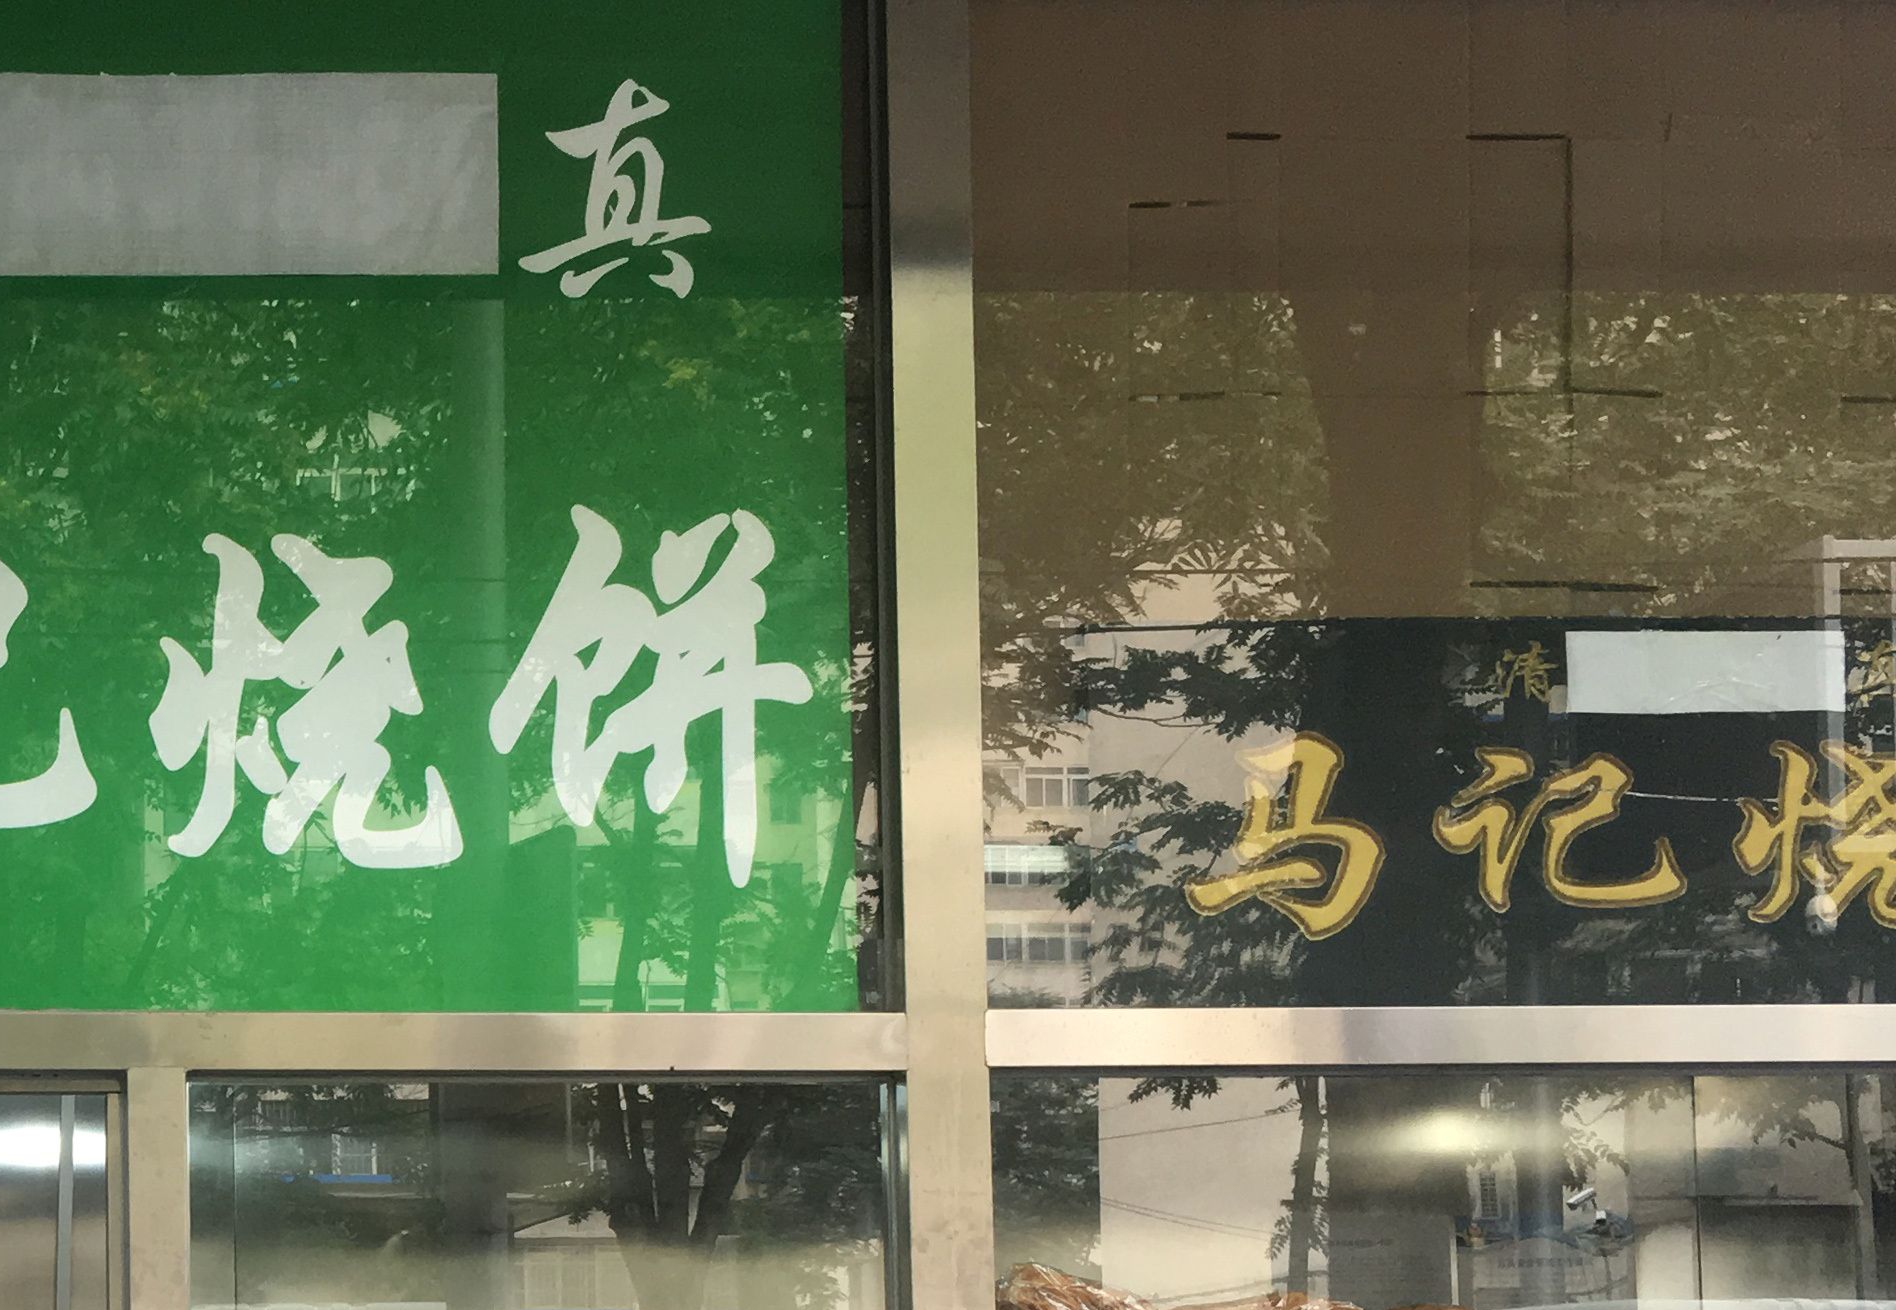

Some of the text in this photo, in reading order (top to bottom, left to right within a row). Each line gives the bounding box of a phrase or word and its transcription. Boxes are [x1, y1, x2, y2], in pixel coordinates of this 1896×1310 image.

[518, 78, 712, 300] 真
[1186, 731, 1896, 940] 马记烧
